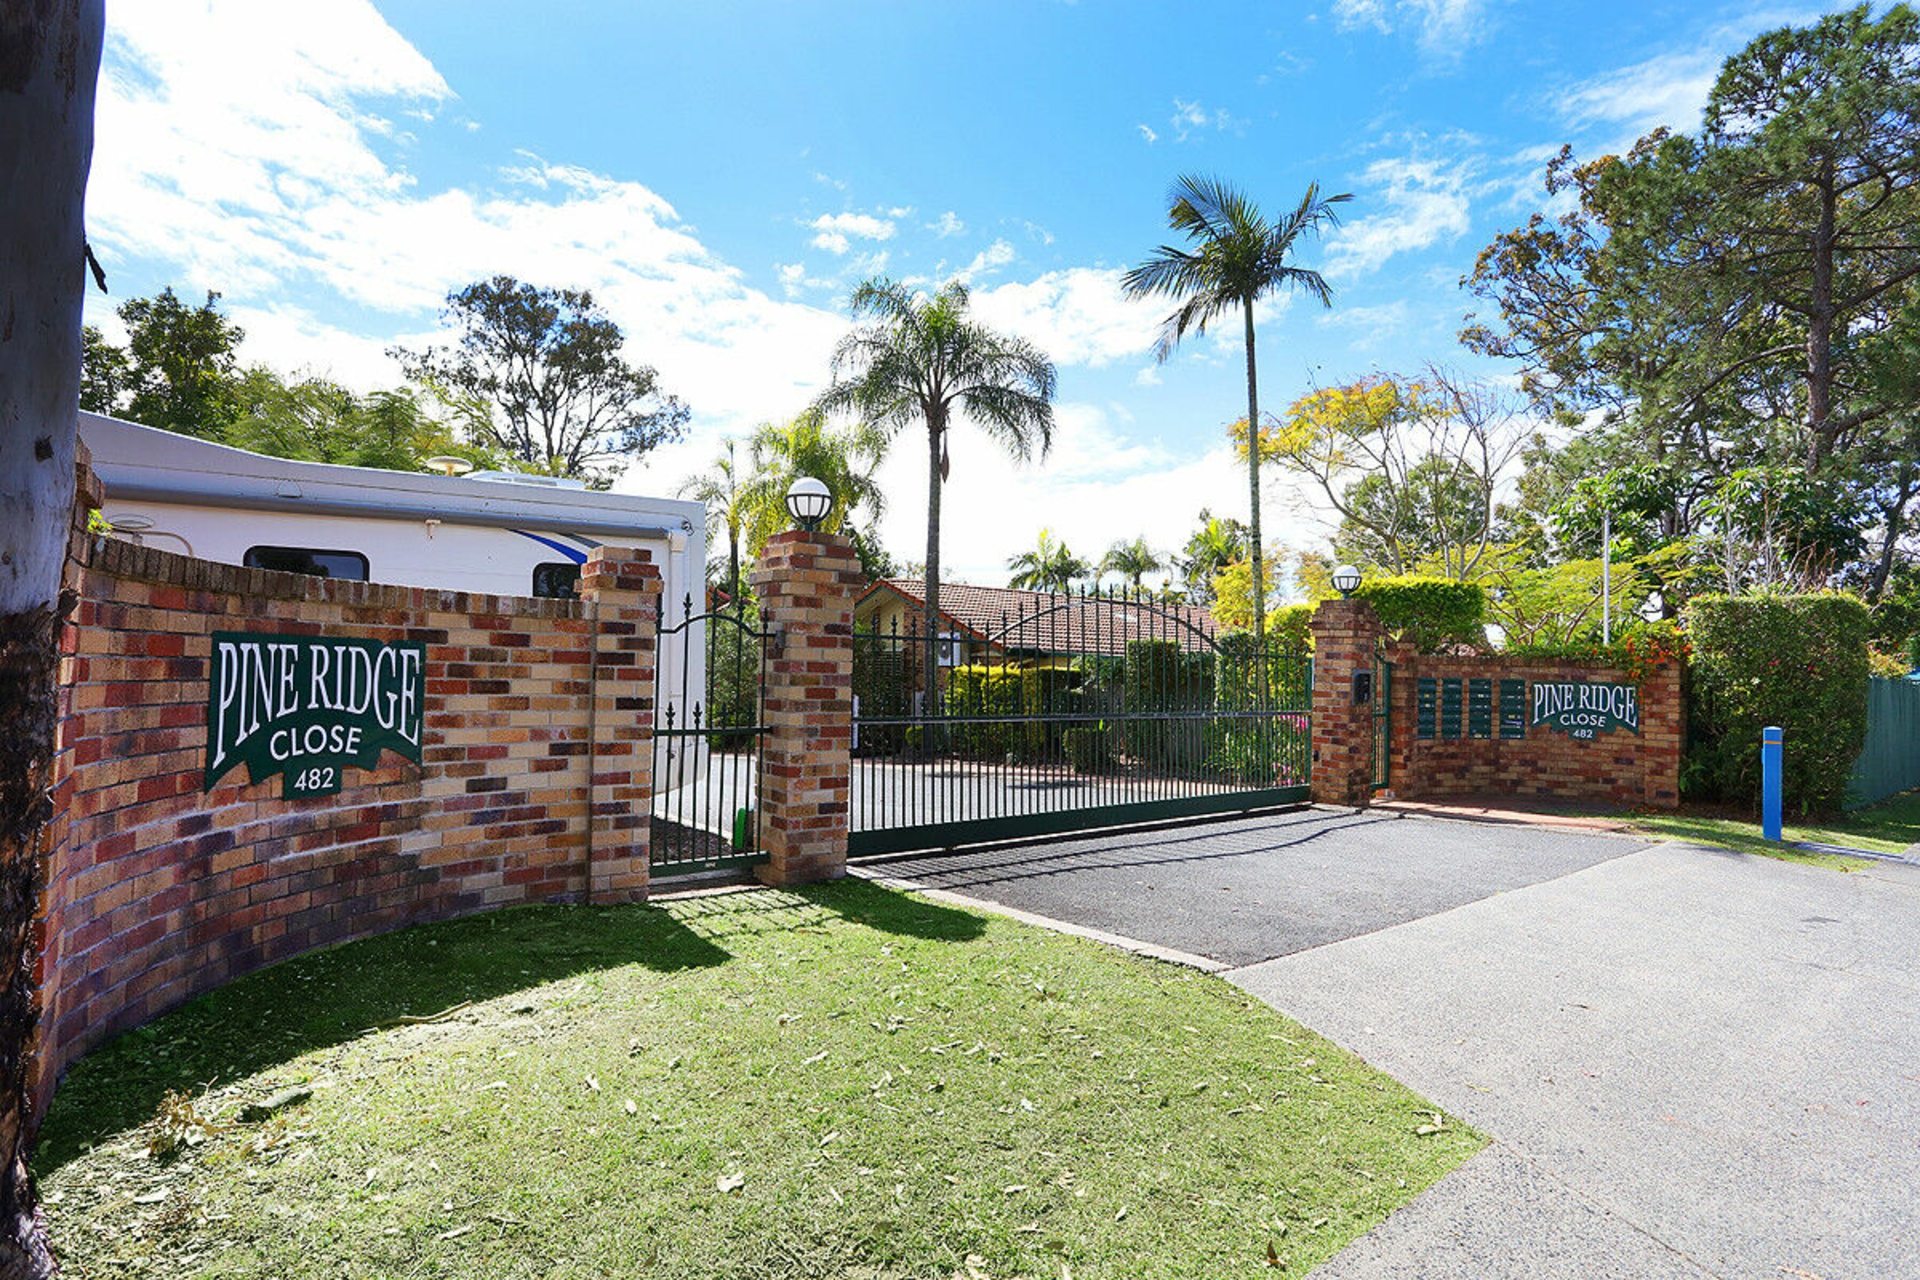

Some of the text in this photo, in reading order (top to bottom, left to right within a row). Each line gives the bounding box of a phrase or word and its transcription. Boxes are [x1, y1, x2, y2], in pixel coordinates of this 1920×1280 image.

[213, 642, 420, 770] PINE RIDGE
[1532, 684, 1637, 727] PINE RIDGE
[1559, 713, 1607, 727] CLOSE
[270, 724, 362, 761] CLOSE
[1572, 729, 1593, 739] 482
[294, 767, 334, 791] 482
